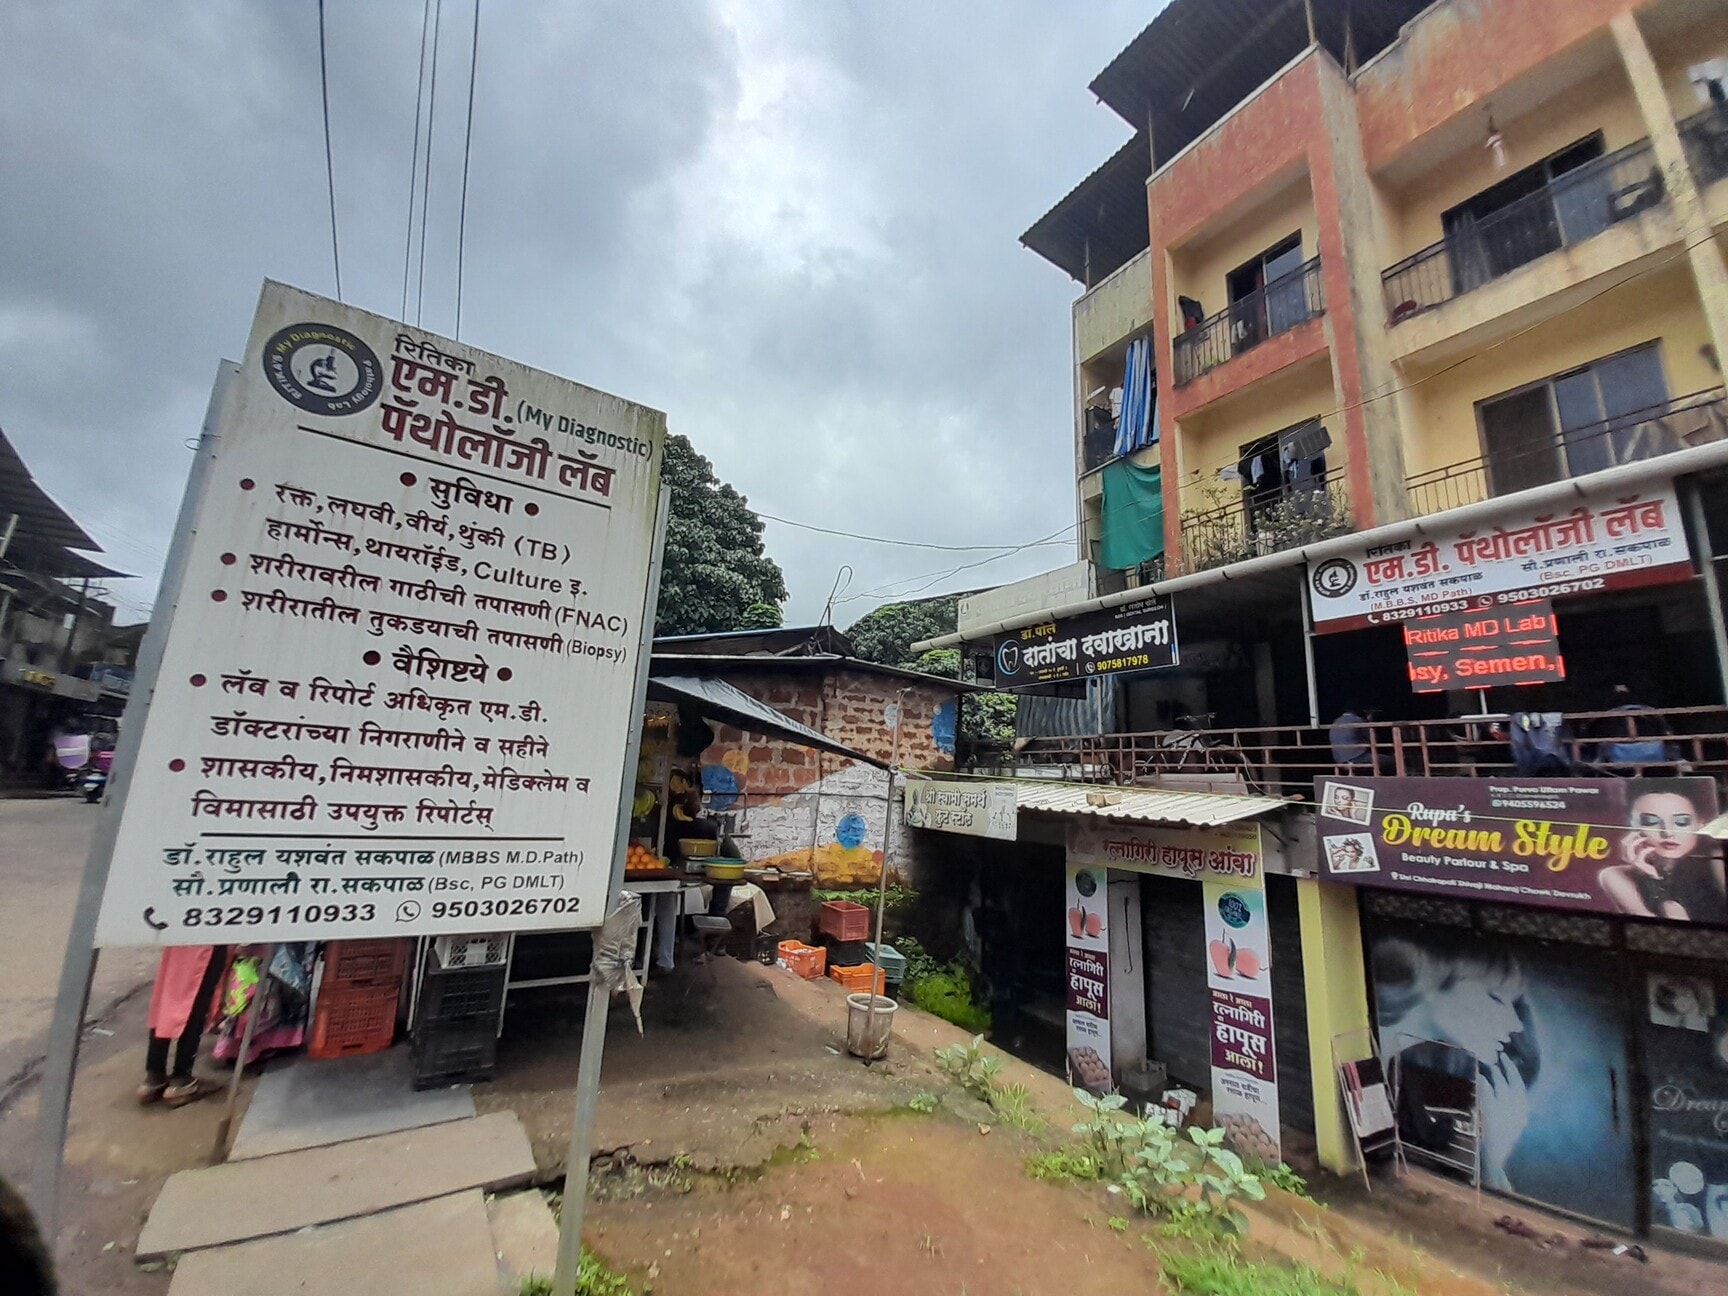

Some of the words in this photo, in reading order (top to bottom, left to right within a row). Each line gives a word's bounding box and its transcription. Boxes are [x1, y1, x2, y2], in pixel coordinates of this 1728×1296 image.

[395, 334, 475, 376] रितिका
[558, 448, 616, 496] लॅब
[428, 476, 514, 515] सुविधा
[1600, 494, 1666, 538] लॅब
[514, 535, 571, 565] (TB)
[250, 553, 382, 592] शरीरावरील
[389, 578, 467, 607] गाठीची
[1579, 563, 1601, 575] PG
[1421, 593, 1439, 602] MD
[1497, 578, 1606, 604] 9503026702
[240, 589, 361, 624] शरीरातील
[1382, 600, 1469, 621] 8329110933
[1022, 636, 1077, 667] दातांचा
[1081, 619, 1169, 658] दवाखाना
[1407, 627, 1460, 645] Ritika
[1464, 619, 1499, 638] MD
[1504, 614, 1546, 633] Lab
[1096, 654, 1149, 671] 9075817978
[220, 668, 270, 696] लॅब
[278, 681, 300, 700] व
[309, 676, 376, 707] रिपोर्ट
[384, 687, 472, 721] अधिकृत
[210, 710, 351, 744] डॉक्टरांच्या
[359, 721, 466, 752] निगराणीने
[474, 737, 491, 754] व
[499, 735, 549, 760] सहीने
[576, 778, 591, 794] व
[191, 789, 318, 820] विमासाठी
[326, 803, 407, 830] उपयुक्त
[275, 843, 347, 866] यशवंत
[355, 850, 436, 866] सकपाळ
[1381, 813, 1504, 853] Dream
[1512, 819, 1610, 871] Style
[1401, 852, 1441, 866] Beauty
[1443, 855, 1487, 869] Parlour
[1489, 859, 1499, 870] &
[1502, 861, 1529, 874] Spa
[481, 876, 506, 890] PG
[182, 903, 377, 927] 8329110933
[432, 897, 581, 919] 9503026702
[1213, 1001, 1265, 1029] रत्नागिरी
